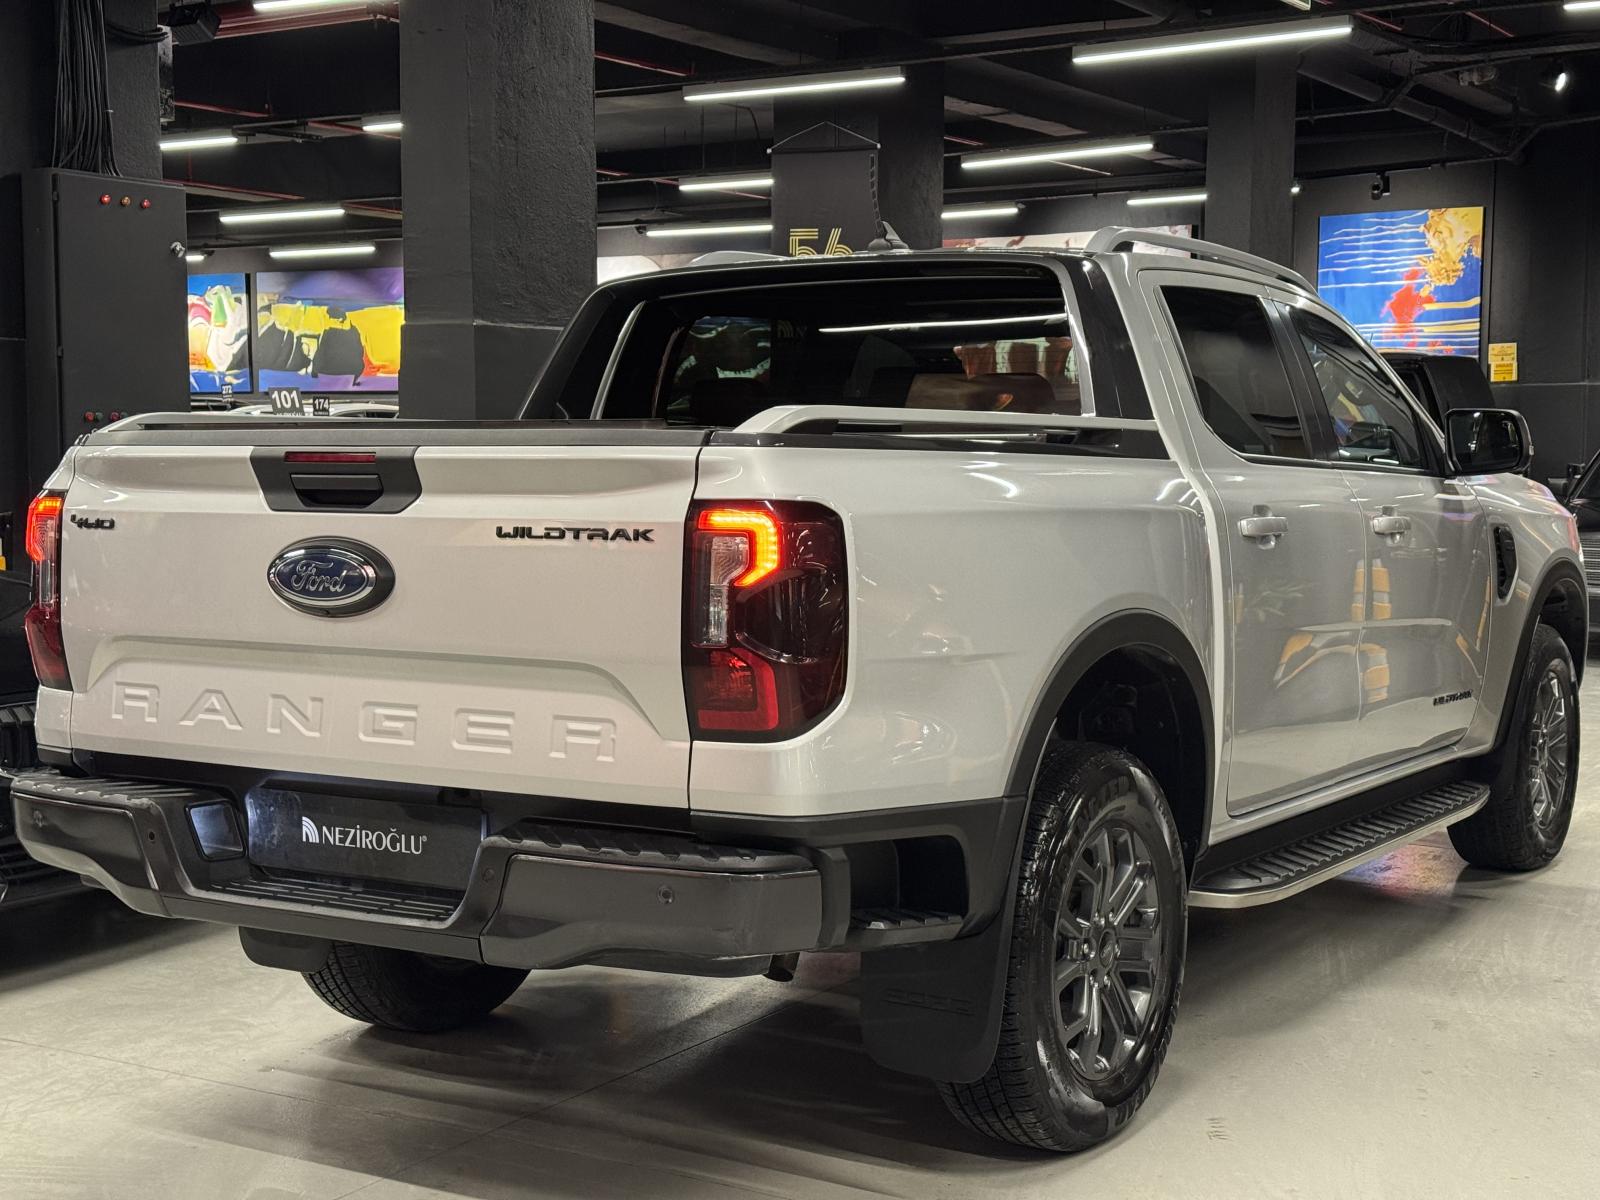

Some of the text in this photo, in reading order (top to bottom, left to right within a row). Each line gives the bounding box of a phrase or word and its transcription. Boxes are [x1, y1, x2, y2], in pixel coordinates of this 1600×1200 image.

[789, 227, 853, 256] 56
[271, 389, 300, 409] 101
[314, 398, 329, 410] 174
[496, 526, 655, 542] WILDTRAK
[290, 559, 347, 592] Ford
[111, 681, 617, 762] RANGER
